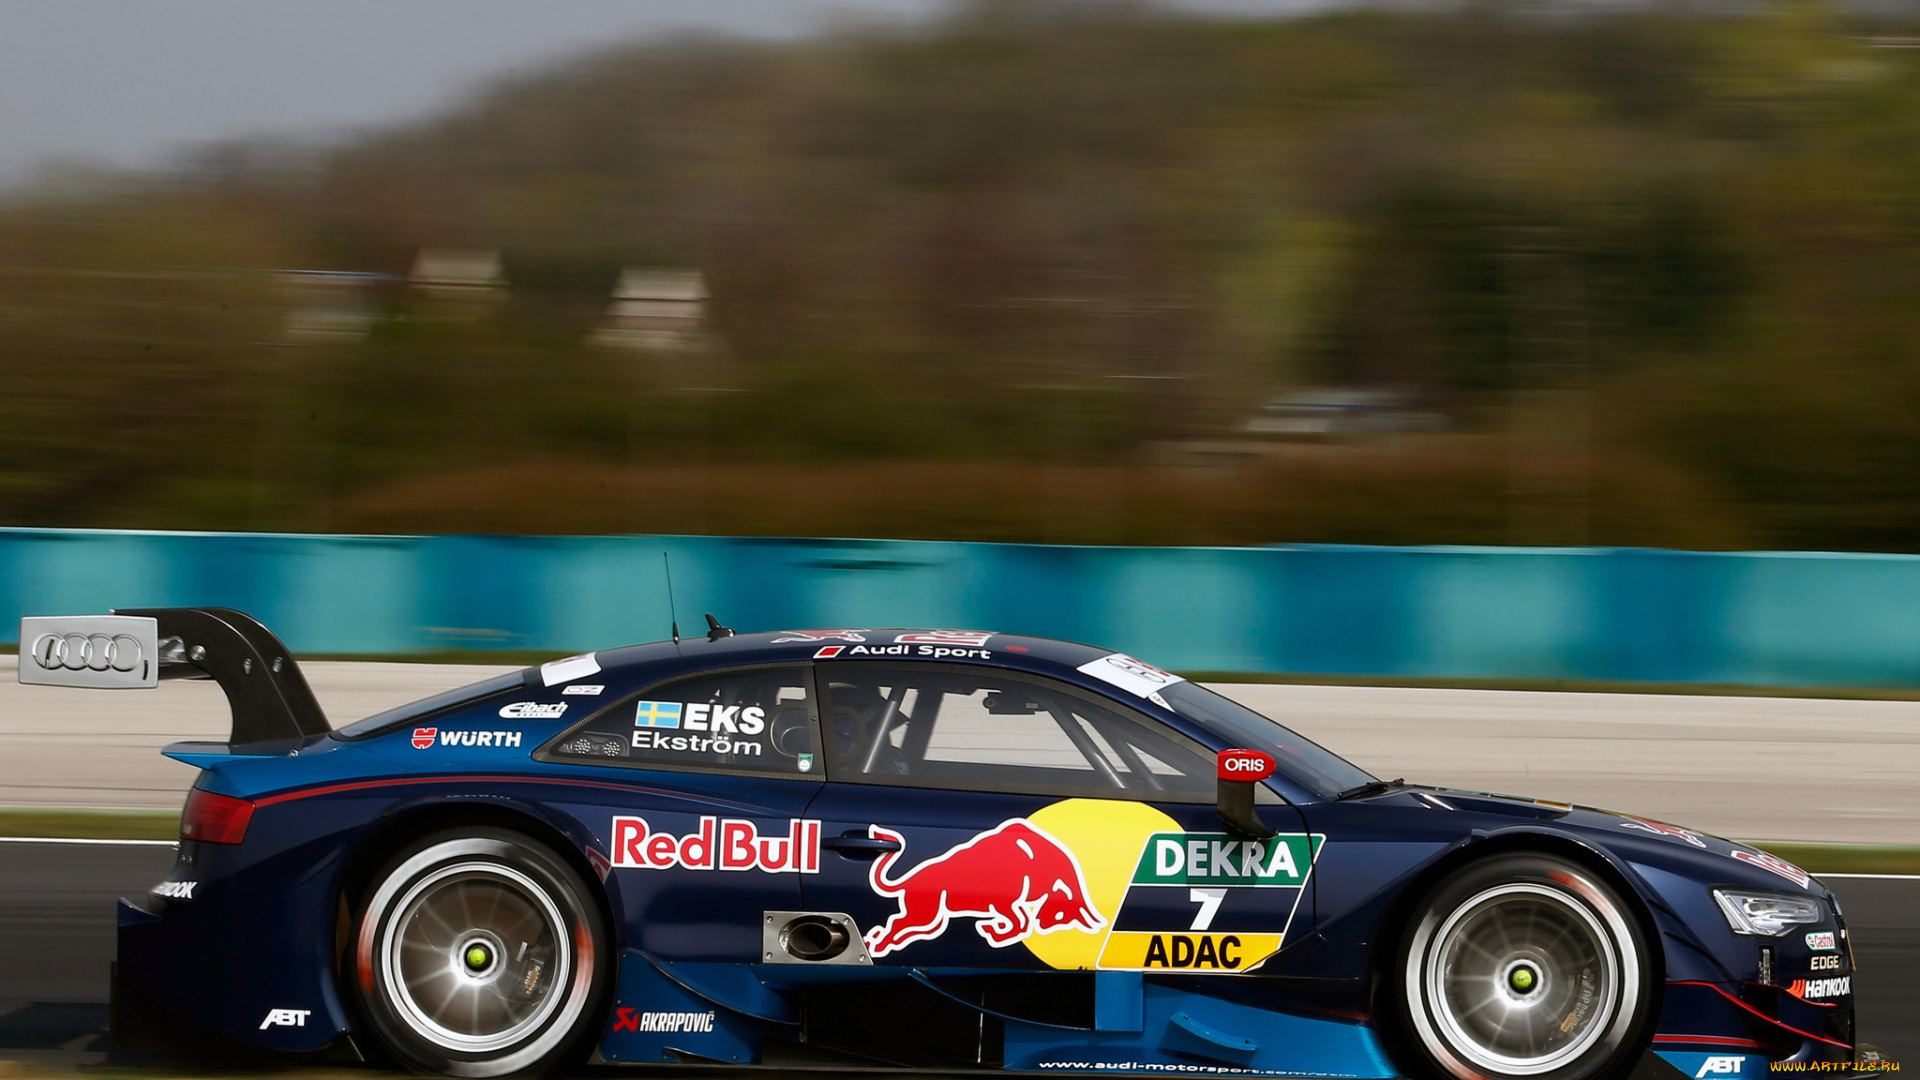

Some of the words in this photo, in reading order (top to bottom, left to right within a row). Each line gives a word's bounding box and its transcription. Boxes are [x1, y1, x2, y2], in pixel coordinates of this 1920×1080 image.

[850, 645, 910, 655] Audi
[918, 645, 992, 660] Sport
[499, 701, 569, 718] Eibach
[684, 703, 766, 735] EKS
[440, 731, 522, 748] WÜRTH
[632, 731, 762, 756] Ekström
[1225, 758, 1265, 772] ORIS
[612, 816, 717, 869] Red
[719, 818, 821, 873] Bull
[1155, 839, 1300, 878] DEKRA
[1189, 888, 1228, 931] 7
[1814, 932, 1836, 948] Castrol
[1143, 935, 1242, 969] ADAC
[1810, 955, 1840, 971] EDGE
[259, 1008, 311, 1030] ABT
[640, 1011, 715, 1033] AKRAPOVIČ
[1695, 1056, 1746, 1079] ABT
